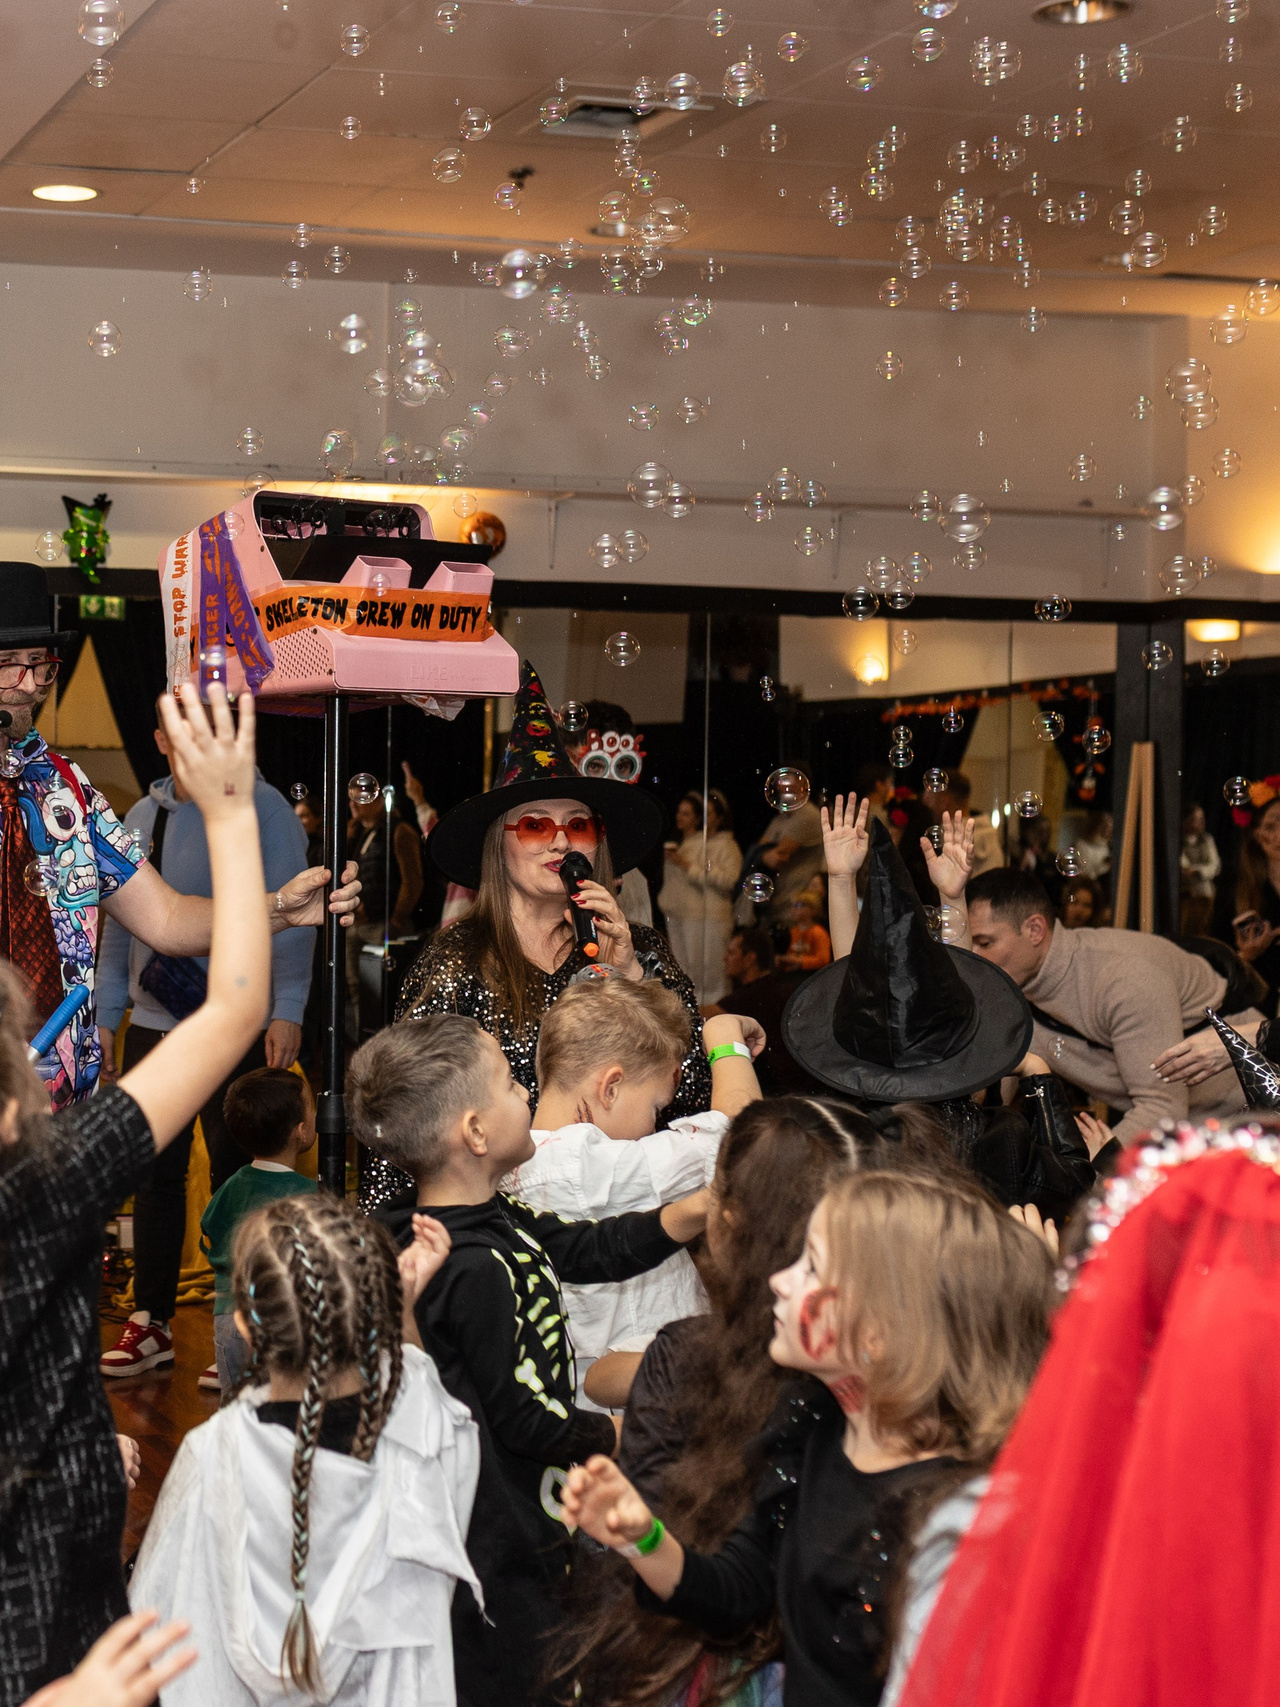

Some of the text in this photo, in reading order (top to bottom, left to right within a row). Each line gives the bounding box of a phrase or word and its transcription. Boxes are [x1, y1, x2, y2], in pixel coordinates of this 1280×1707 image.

[171, 531, 191, 638] STOP WAR
[265, 595, 482, 634] SKELETON CREW ON DUTY
[206, 593, 220, 679] DNGER
